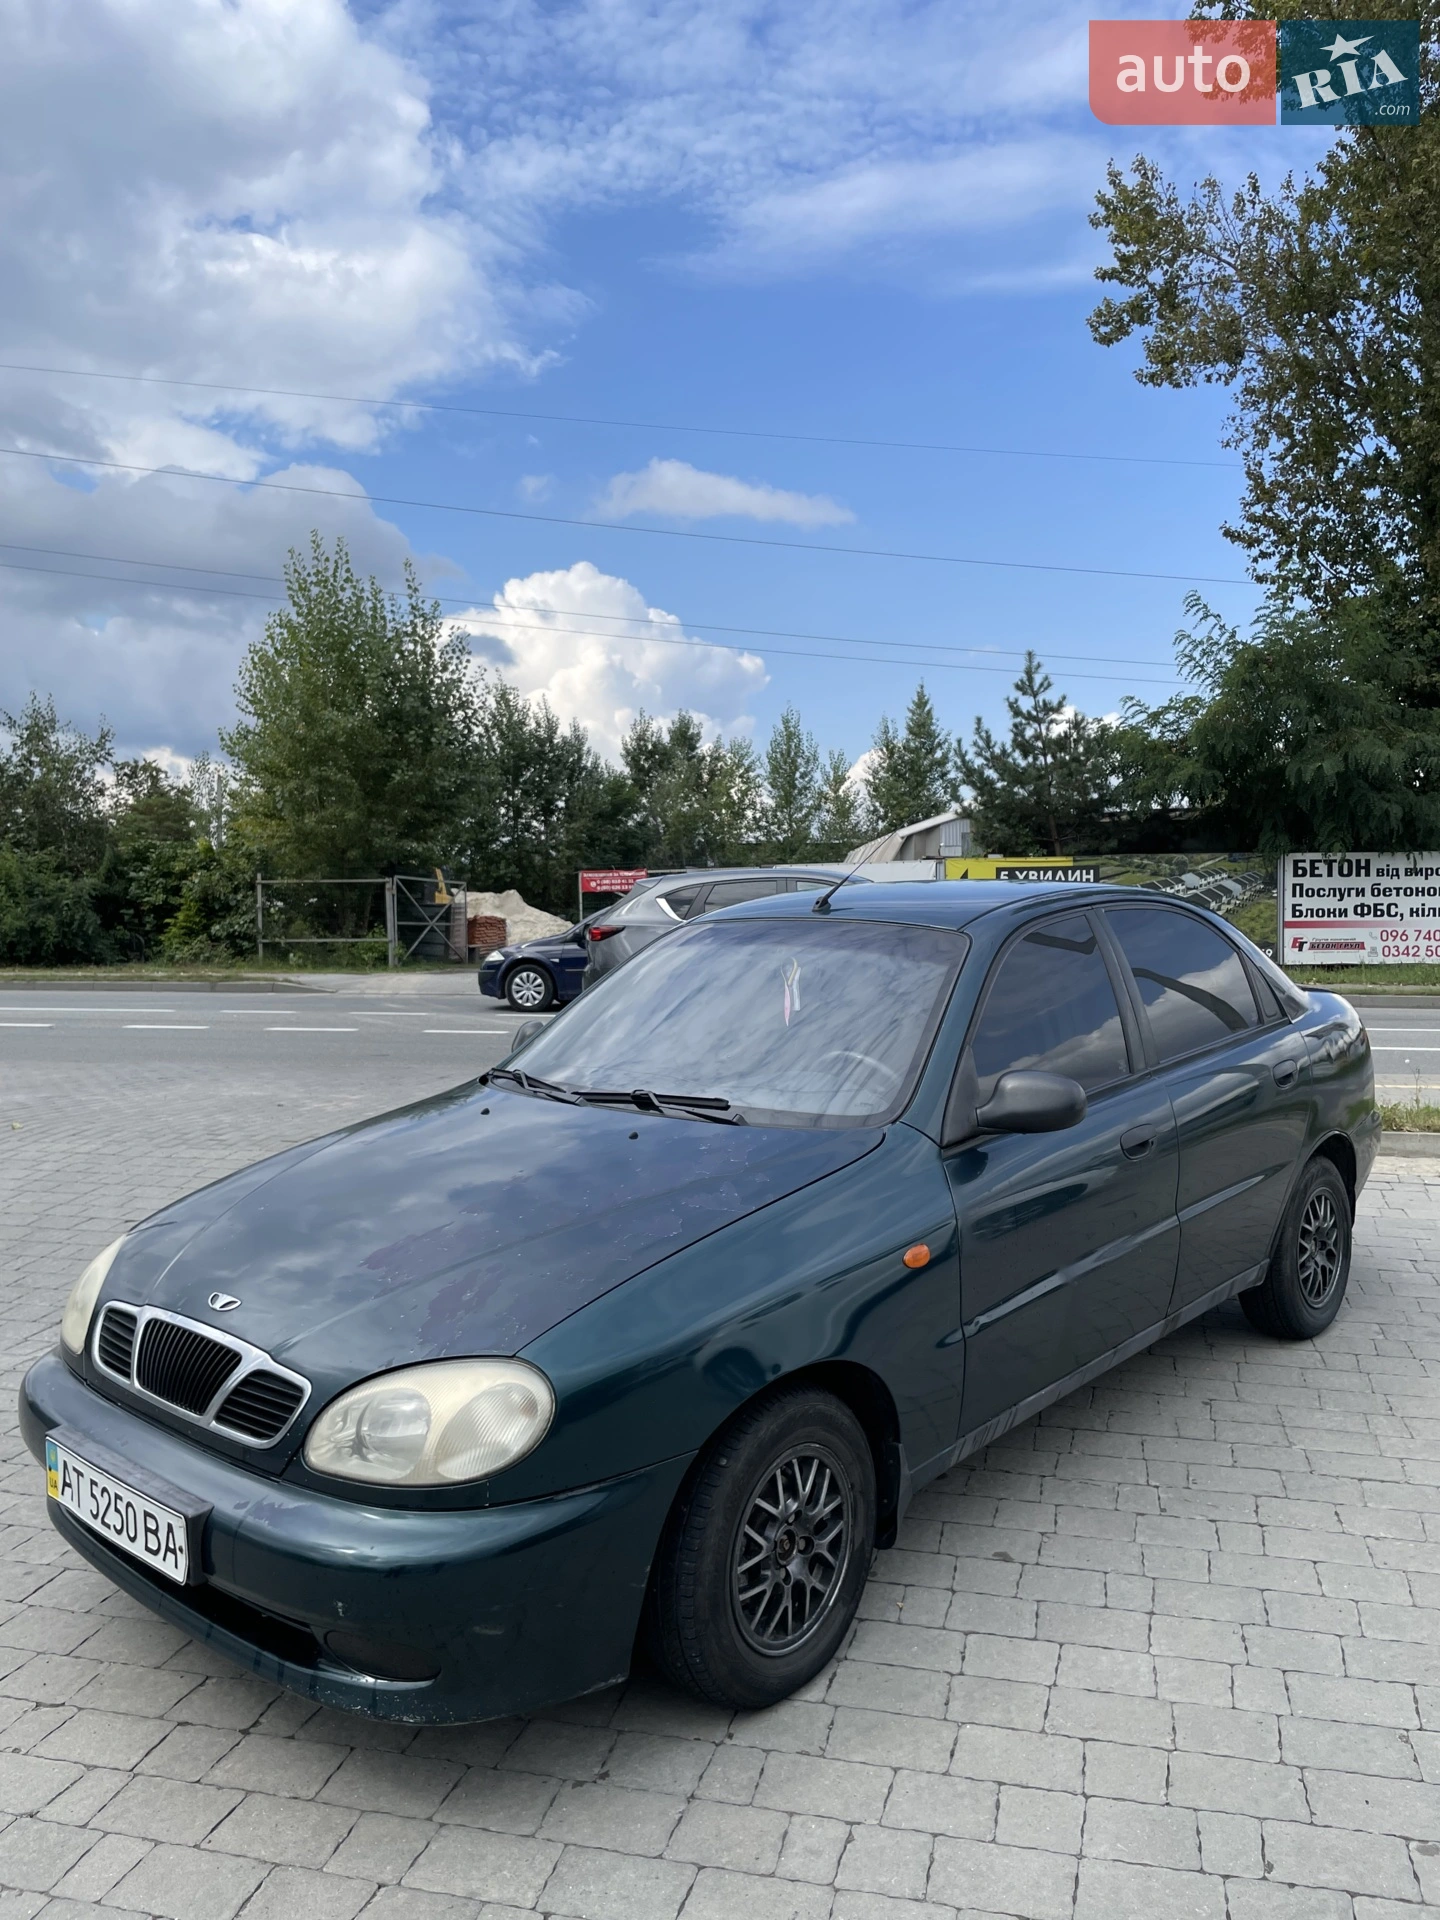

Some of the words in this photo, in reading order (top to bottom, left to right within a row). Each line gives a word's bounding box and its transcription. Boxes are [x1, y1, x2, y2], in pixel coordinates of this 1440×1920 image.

[1015, 869, 1094, 883] ХВИЛИН
[1292, 858, 1371, 878] БЕТОН
[1376, 864, 1400, 880] від
[1291, 883, 1366, 901] Послуги
[1370, 882, 1440, 898] бетоно
[1291, 903, 1348, 918] Блоки
[1353, 903, 1404, 921] ФБС,
[1409, 903, 1440, 918] кіл
[1380, 929, 1409, 942] 096
[1413, 929, 1440, 942] 740
[1382, 945, 1420, 957] 0342
[49, 1476, 59, 1491] UA
[61, 1459, 85, 1509] AT
[89, 1477, 138, 1543] 5250
[143, 1509, 179, 1570] BA
